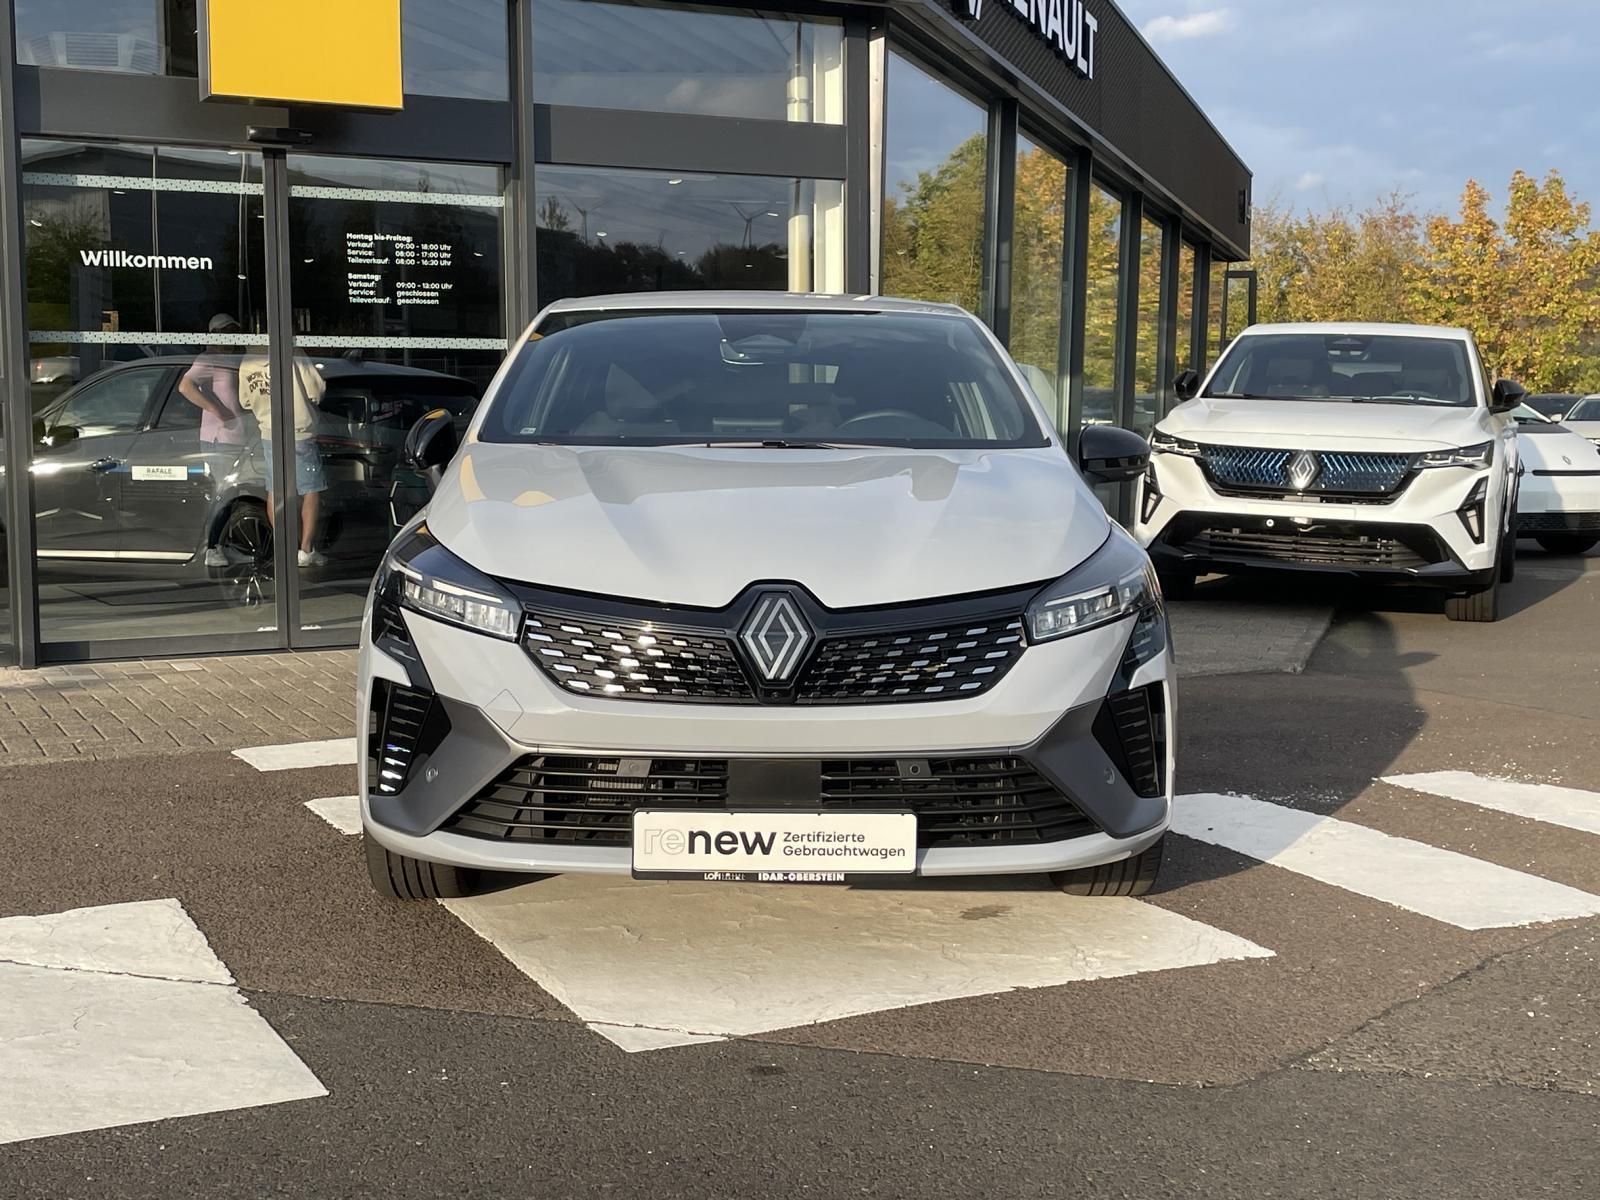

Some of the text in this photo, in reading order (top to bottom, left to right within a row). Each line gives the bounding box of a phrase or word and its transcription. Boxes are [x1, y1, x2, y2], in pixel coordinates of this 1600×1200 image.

[1008, 0, 1098, 80] AULT
[346, 233, 373, 241] Montag
[80, 250, 213, 270] Willkommen
[348, 273, 381, 281] Samstag:
[396, 290, 439, 298] geschlossen
[643, 828, 866, 856] renew Zertifizierte
[783, 845, 906, 860] Gebrauchtwagen
[758, 872, 845, 882] IDAR-OBERSTEIN
